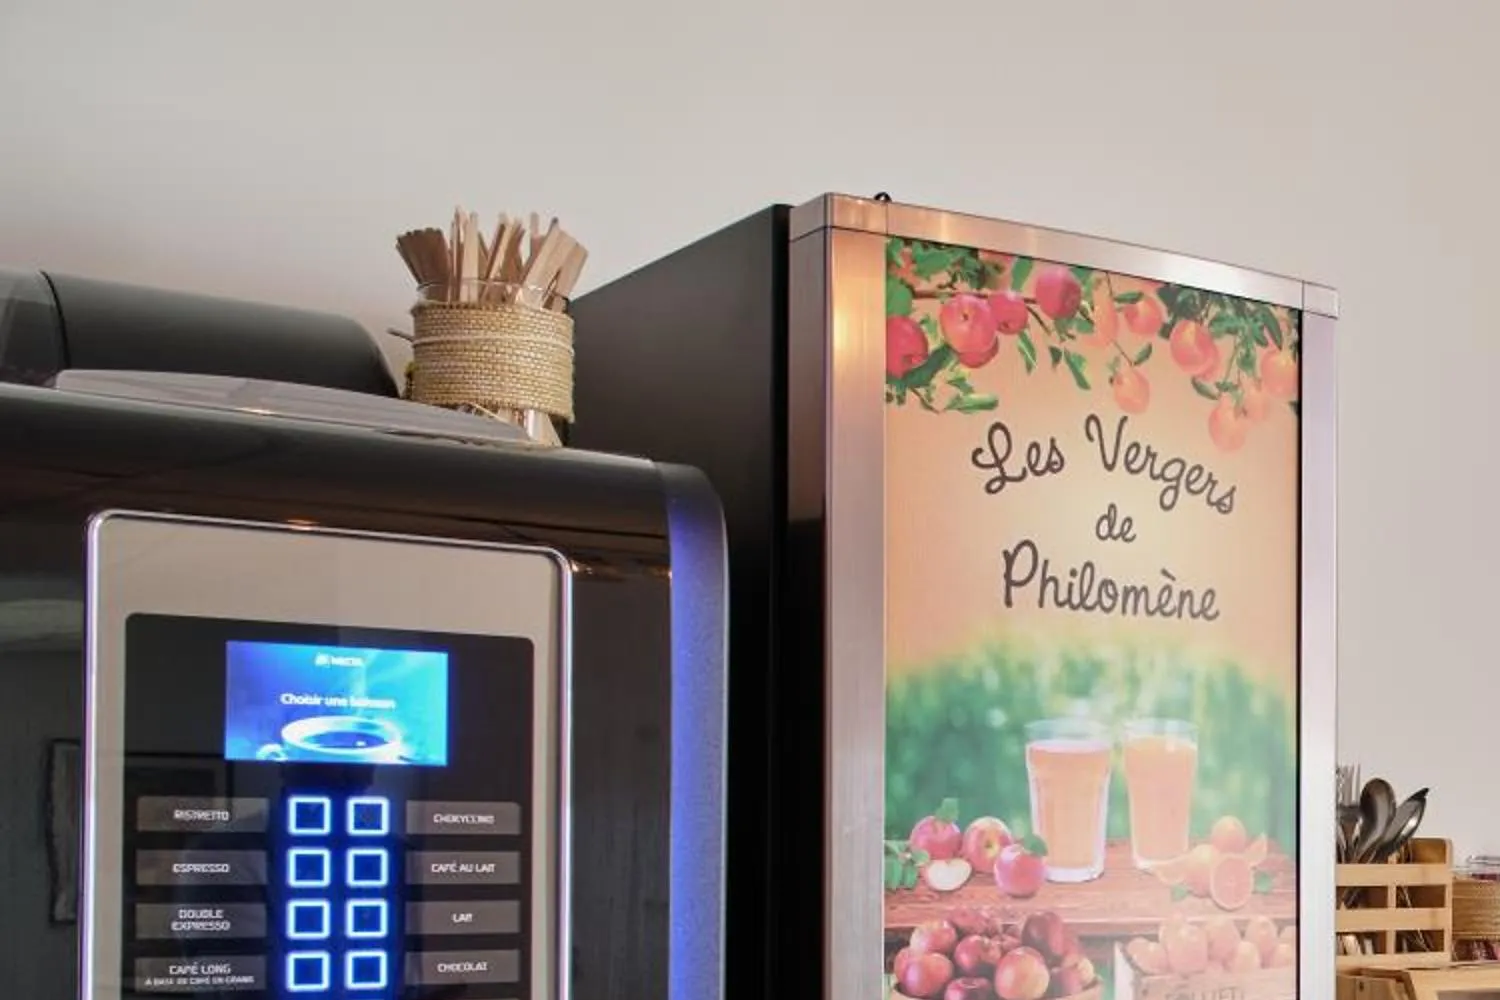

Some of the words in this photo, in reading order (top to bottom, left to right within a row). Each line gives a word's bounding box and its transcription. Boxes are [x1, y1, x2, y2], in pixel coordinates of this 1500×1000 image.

[971, 421, 1066, 495] Les
[1085, 413, 1237, 515] Vergers
[1095, 503, 1137, 543] de
[1003, 539, 1220, 621] Philomène
[172, 863, 230, 873] ESPRESSO
[431, 860, 457, 873] CAFÉ
[459, 864, 474, 873] AU
[475, 863, 496, 873] LAIT
[178, 909, 224, 919] DOUBLE
[168, 962, 199, 975] CAFÉ
[201, 964, 232, 975] LONG
[437, 961, 488, 973] CHOCOLAT
